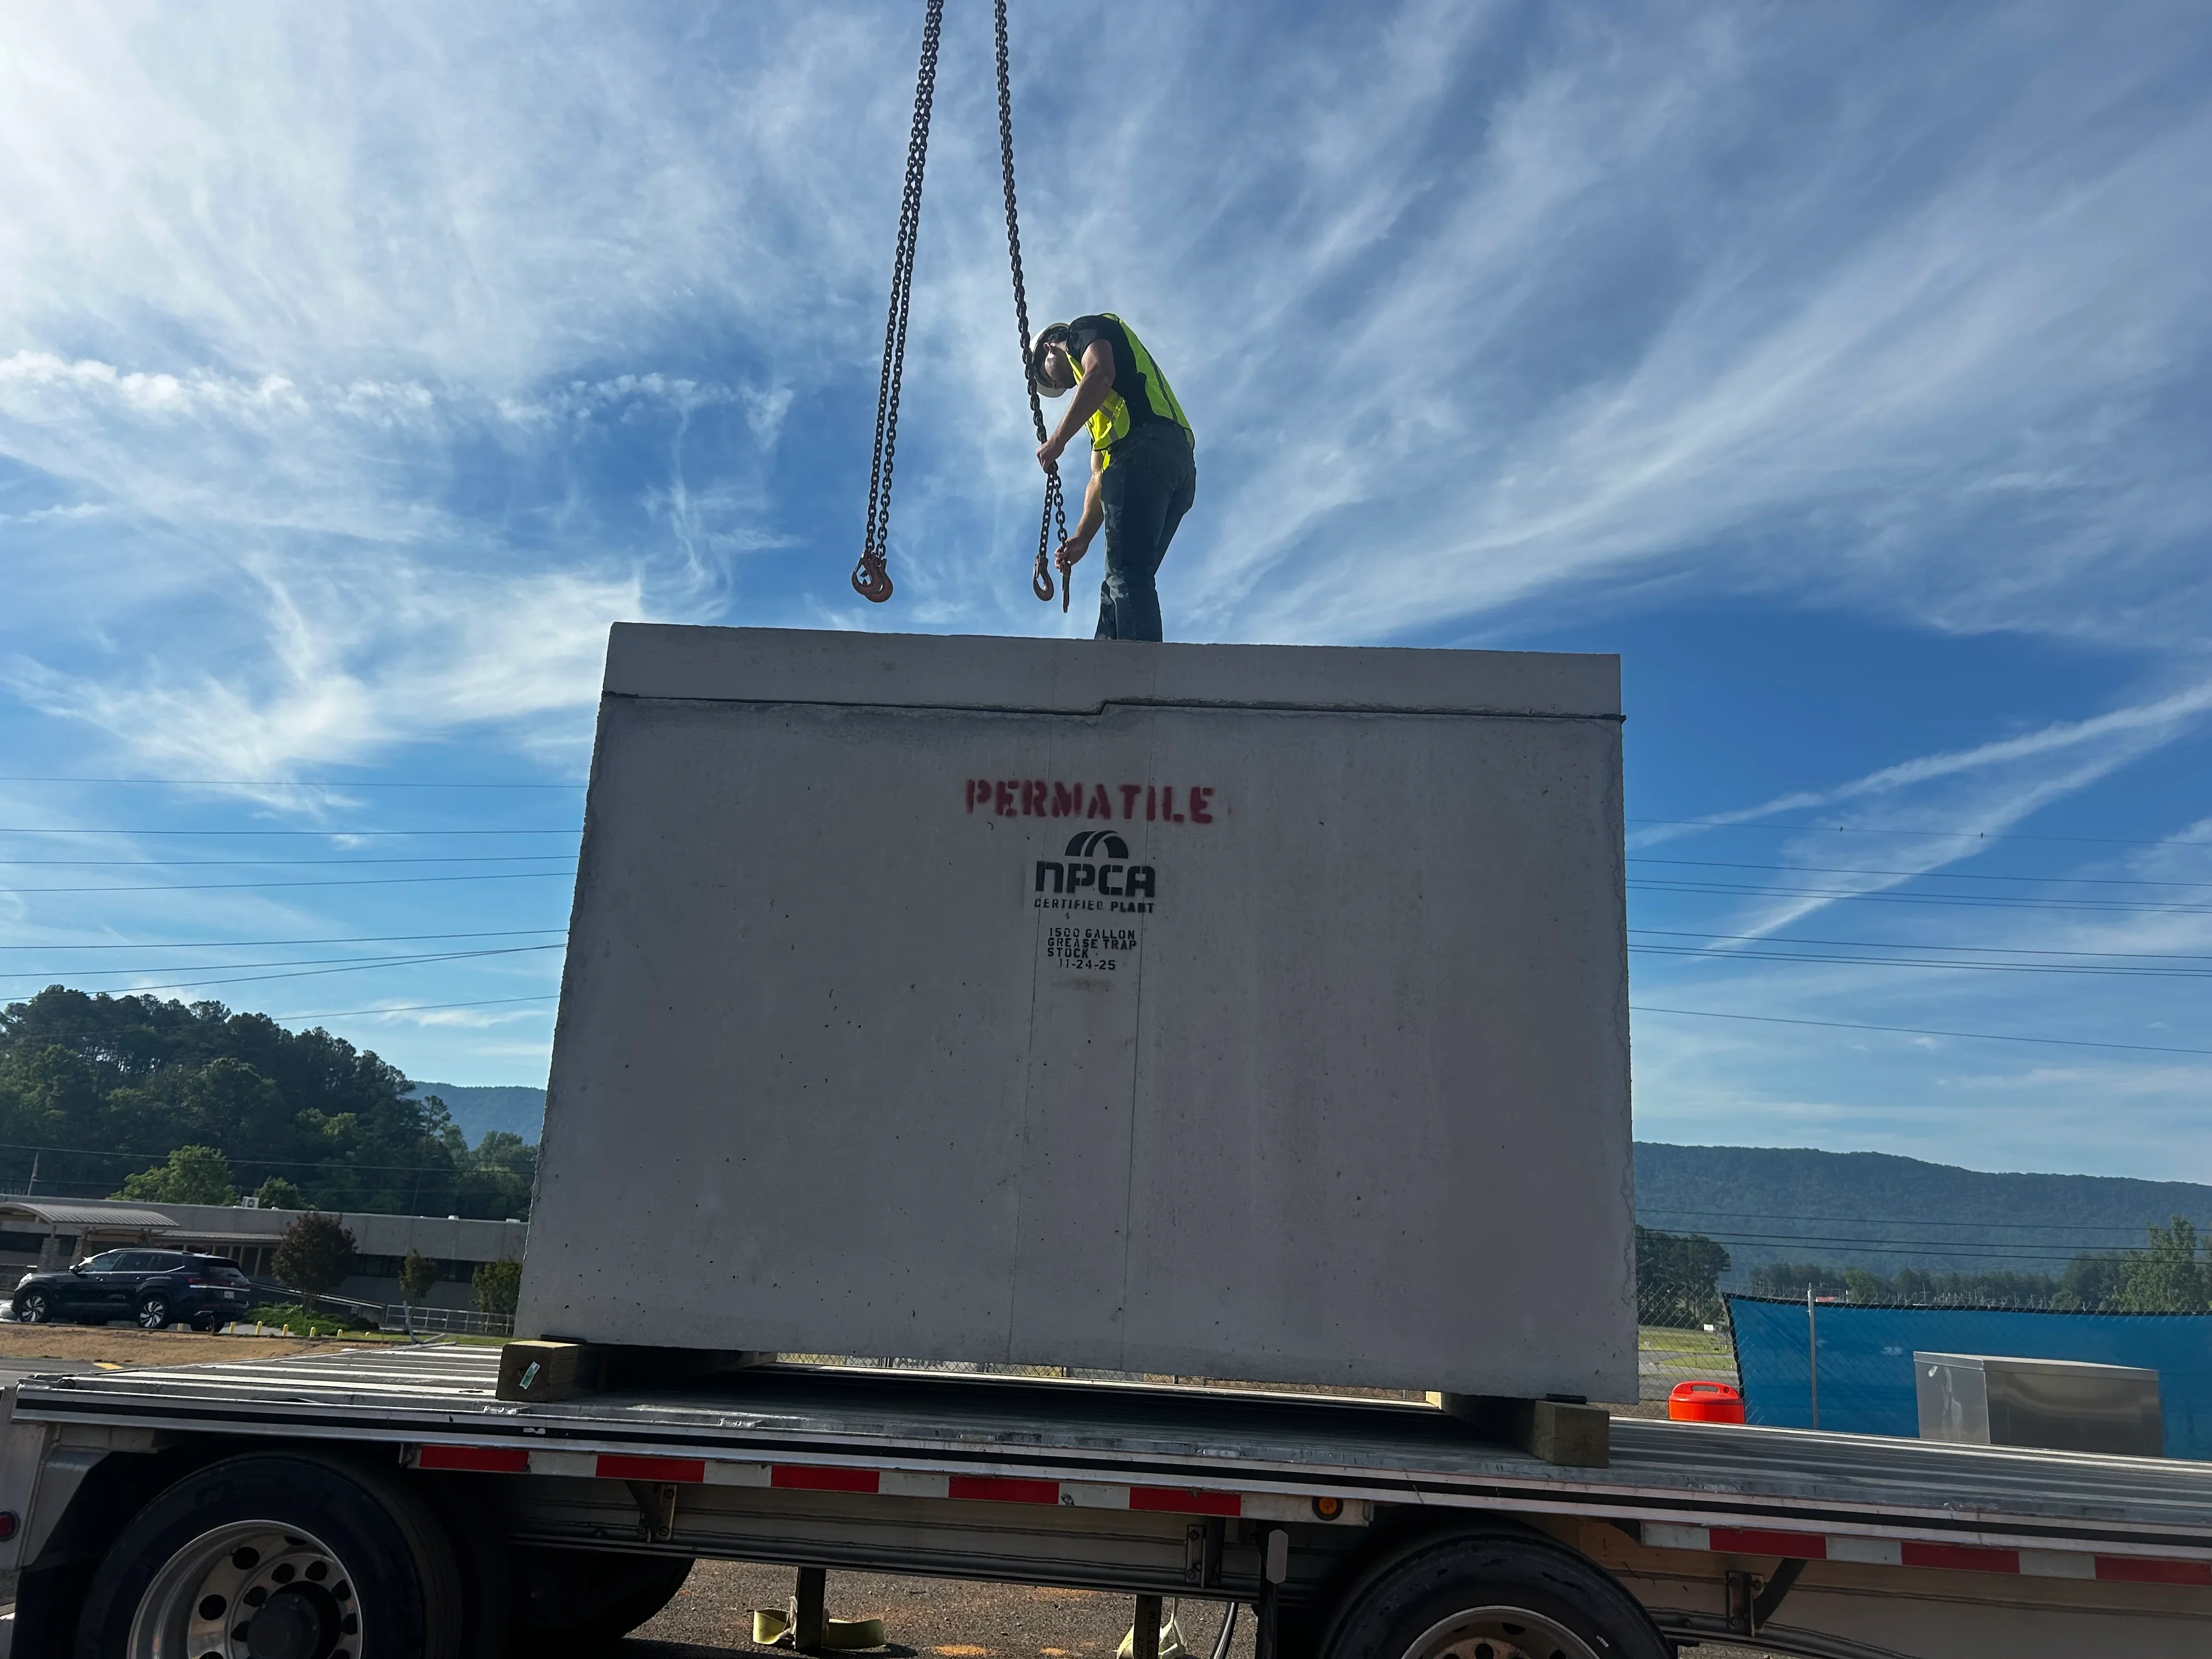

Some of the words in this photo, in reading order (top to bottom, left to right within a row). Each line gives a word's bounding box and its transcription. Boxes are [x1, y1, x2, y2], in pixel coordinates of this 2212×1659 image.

[966, 779, 1215, 825] PERMATILE
[1035, 898, 1103, 911] CERTIFIED
[1110, 901, 1155, 913] PLANT
[1049, 928, 1080, 938] 1500
[1085, 928, 1135, 940] GALLON
[1048, 937, 1098, 949] GREASE
[1103, 939, 1137, 950] TRAP
[1047, 947, 1089, 958] STOCK
[1059, 958, 1116, 970] 11-24-25
